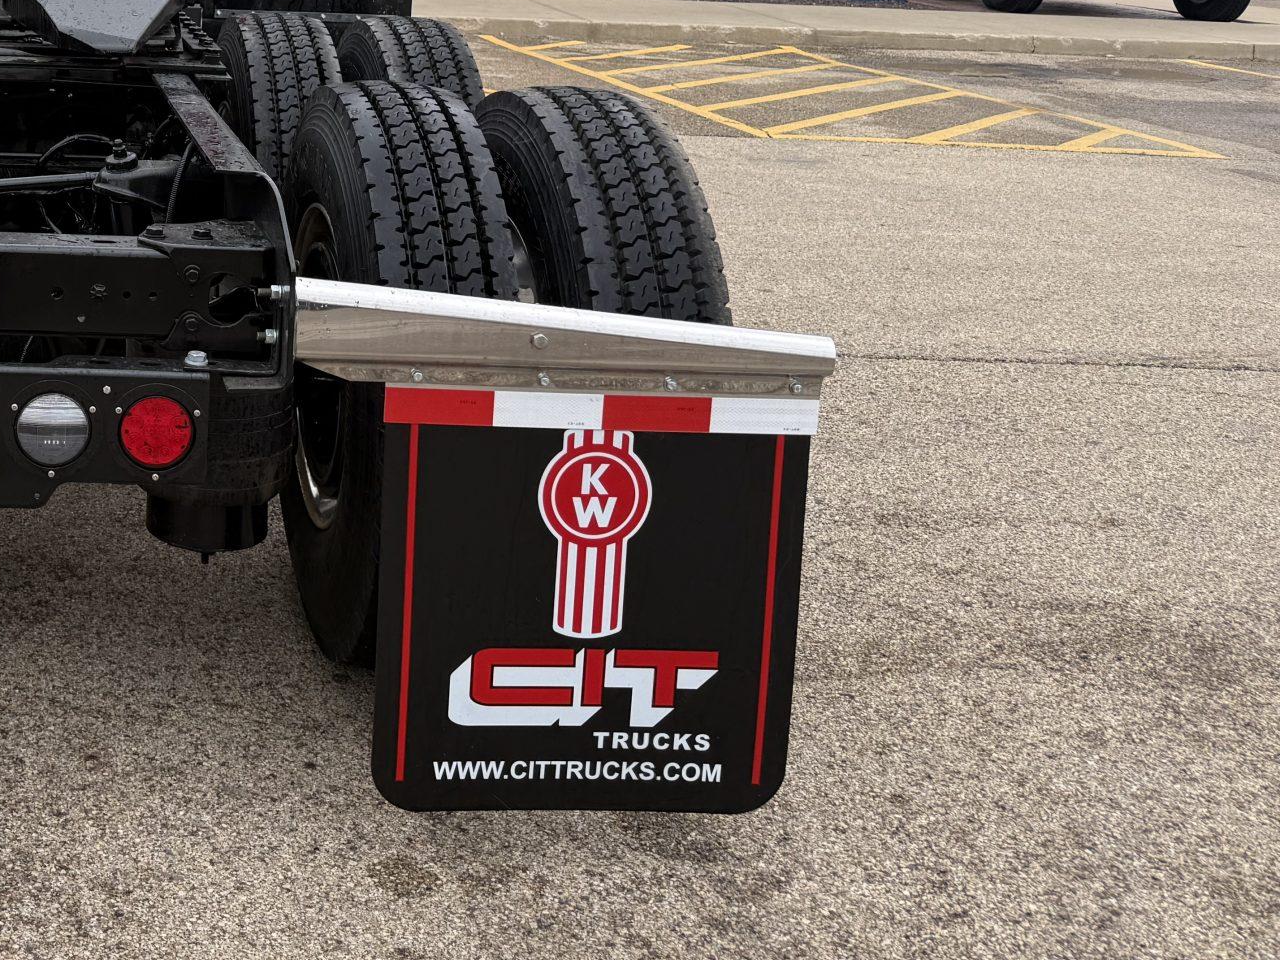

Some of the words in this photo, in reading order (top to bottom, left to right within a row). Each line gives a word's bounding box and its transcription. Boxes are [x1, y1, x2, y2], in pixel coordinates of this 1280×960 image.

[448, 647, 719, 727] CIT
[593, 731, 711, 751] TRUCKS
[433, 760, 722, 784] WWW.CITTRUCKS.COM
